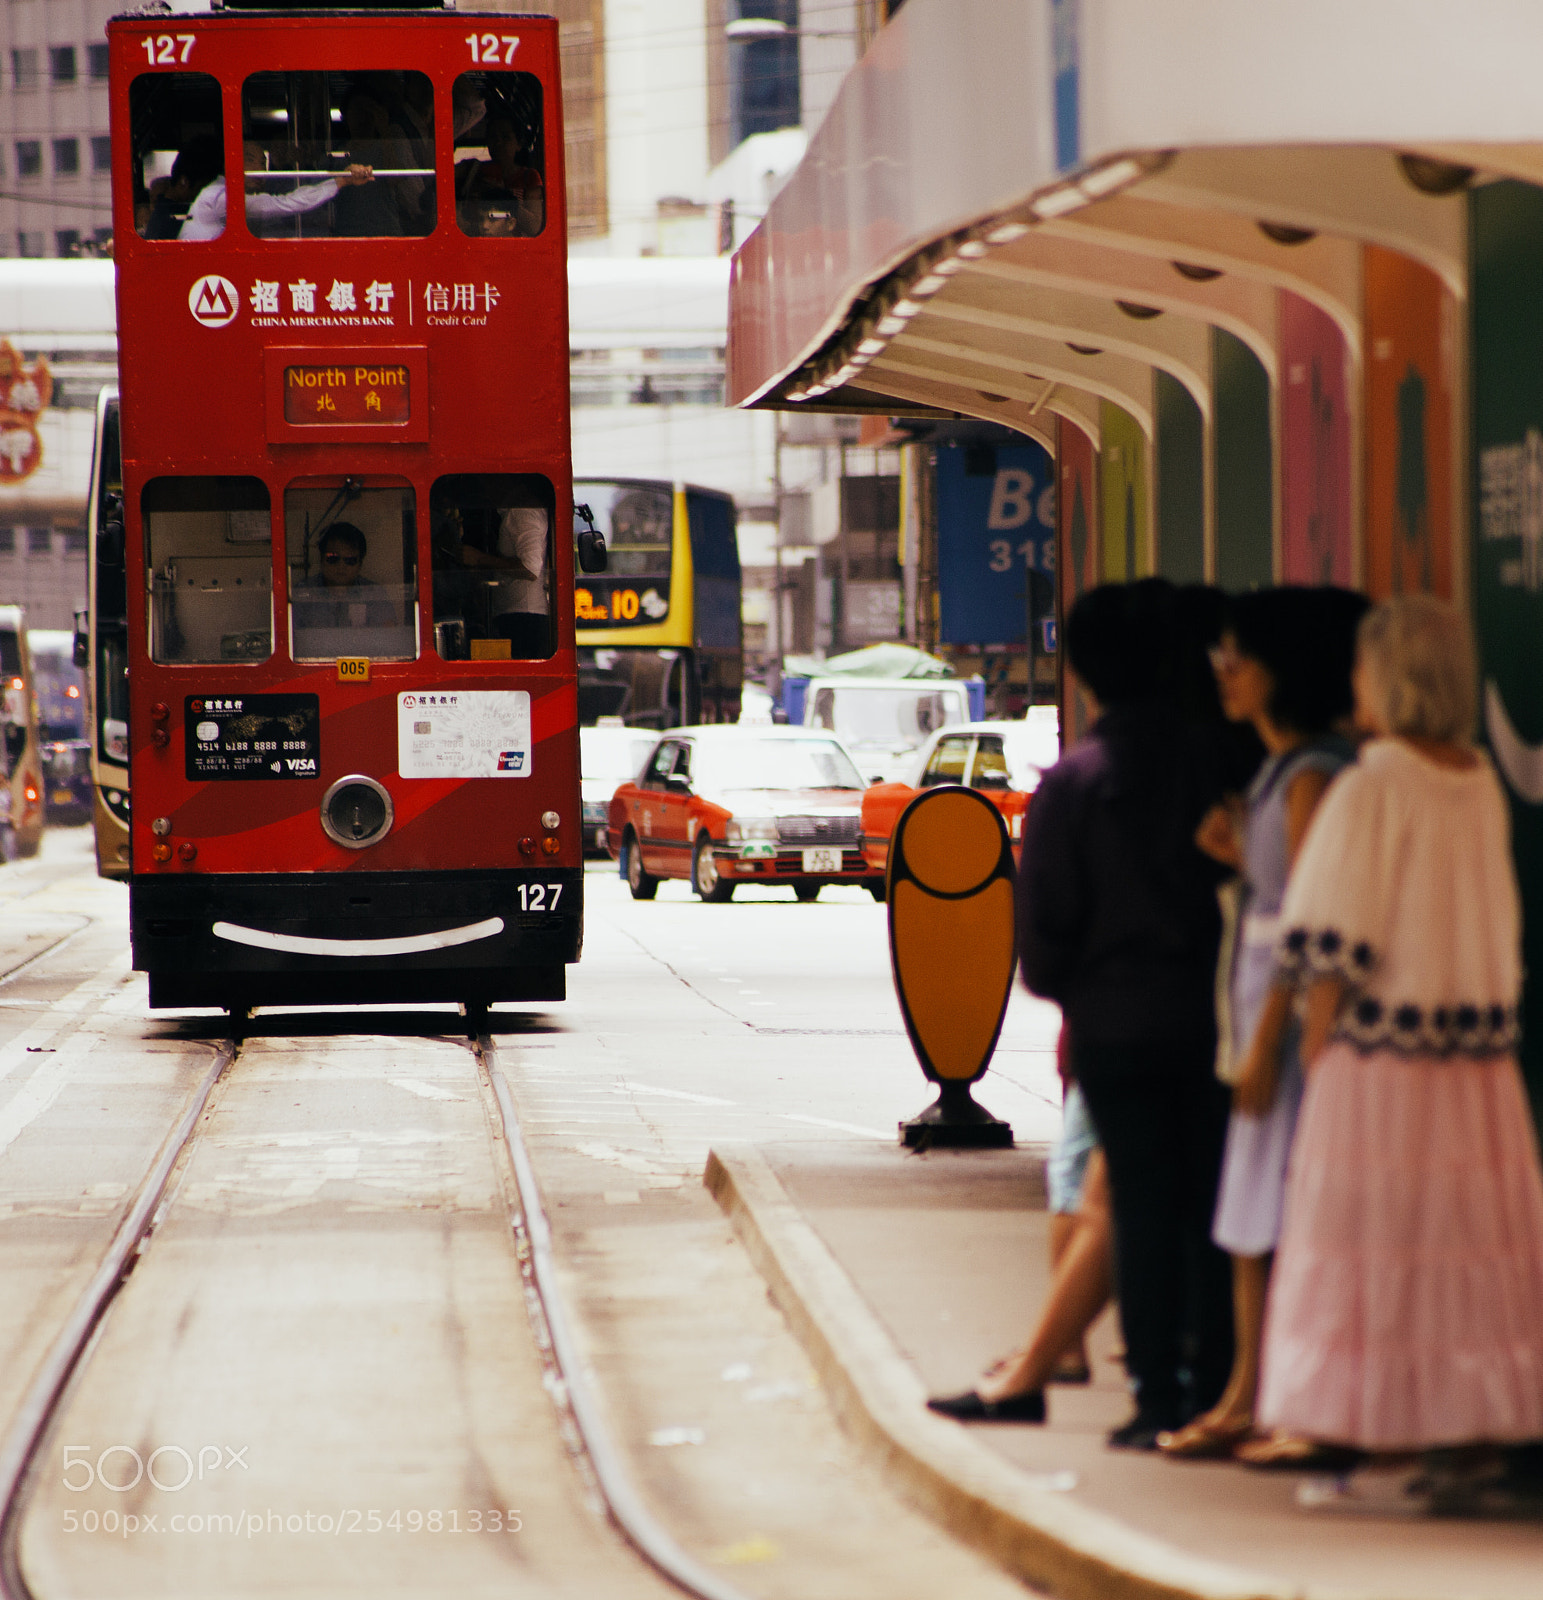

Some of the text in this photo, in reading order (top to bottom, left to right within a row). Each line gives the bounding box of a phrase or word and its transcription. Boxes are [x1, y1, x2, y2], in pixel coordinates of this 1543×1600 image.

[141, 34, 196, 66] 127
[465, 32, 520, 65] 127
[249, 278, 394, 313] 招商銀行
[423, 281, 501, 312] 信用卡
[251, 316, 395, 327] CHINA MERCHANTS BANK
[427, 315, 487, 326] Credit Card
[288, 366, 406, 387] North Point
[316, 391, 381, 412] 北角
[612, 588, 640, 620] 10
[341, 661, 366, 675] 005
[197, 742, 219, 752] 4514
[254, 741, 277, 751] 8888
[283, 741, 306, 750] 8888
[284, 758, 316, 770] VISA
[517, 883, 563, 911] 127
